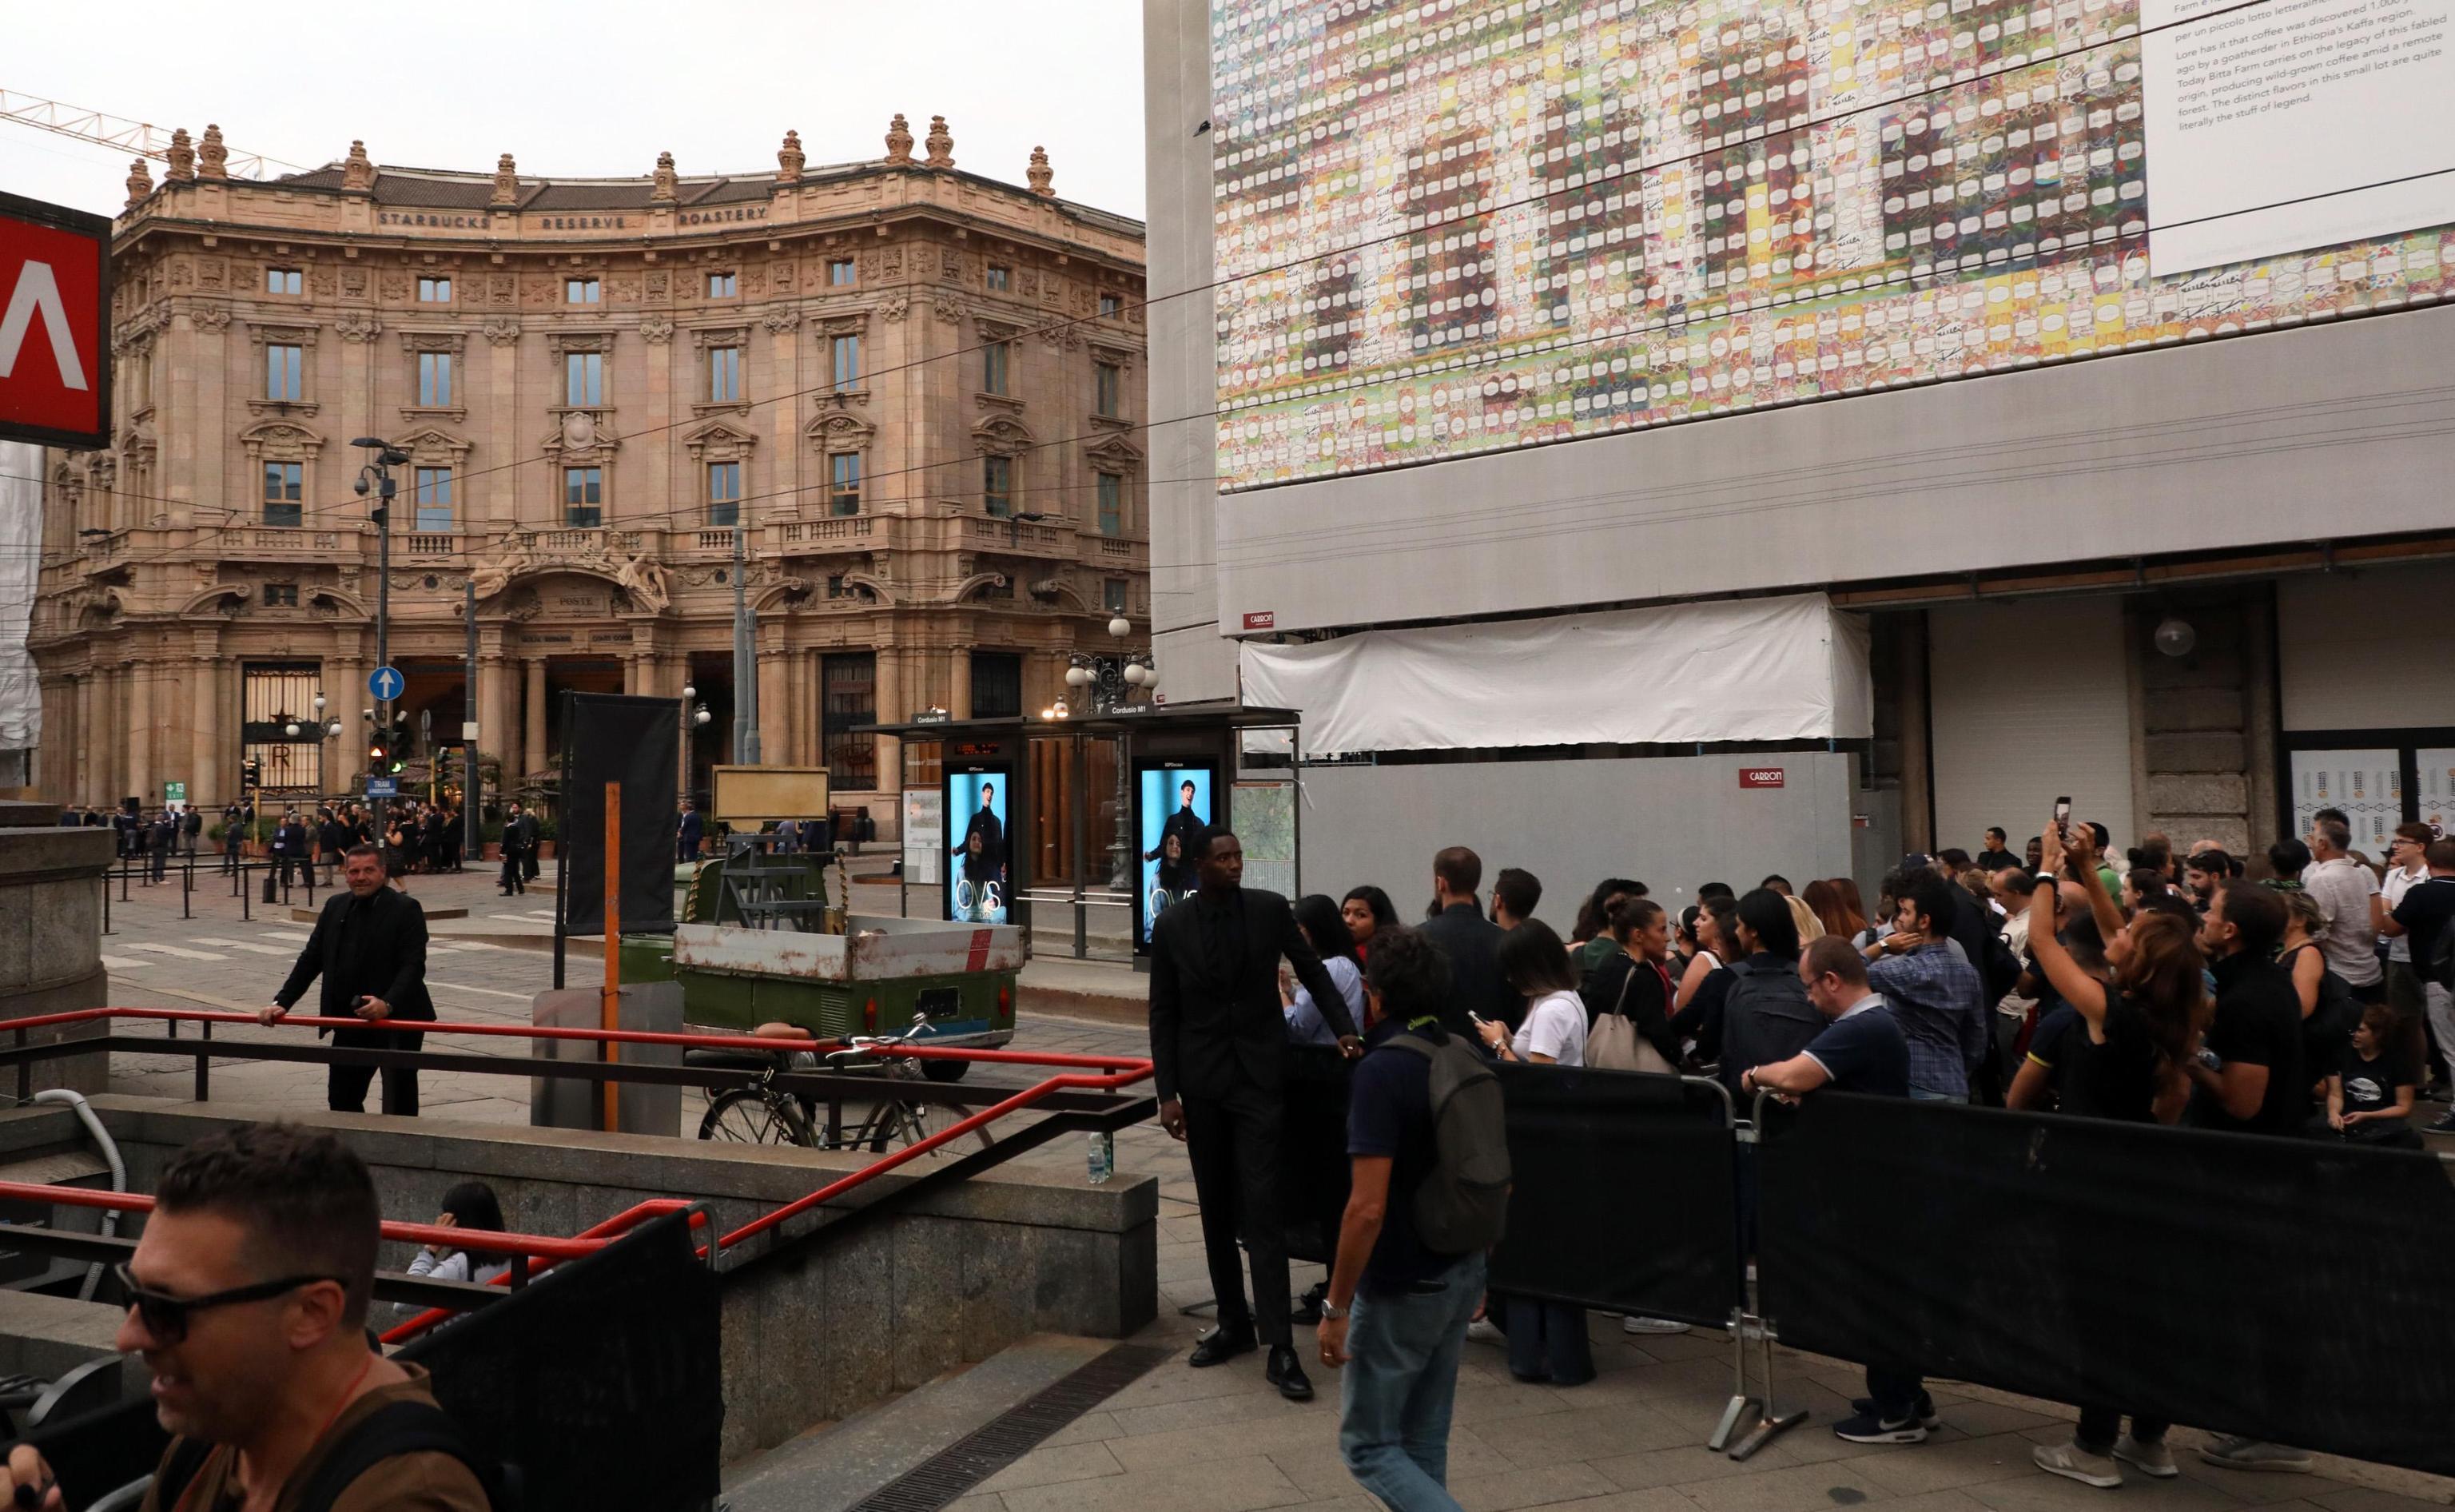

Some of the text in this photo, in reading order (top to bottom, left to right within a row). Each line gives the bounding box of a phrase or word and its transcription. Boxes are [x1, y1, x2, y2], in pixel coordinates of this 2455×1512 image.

[2174, 2, 2198, 13] Farm
[2175, 32, 2191, 44] per
[2194, 28, 2206, 37] un
[2210, 18, 2245, 34] piccolo
[2248, 10, 2272, 25] lotto
[2176, 49, 2197, 60] Lore
[2200, 44, 2217, 54] has
[2229, 36, 2249, 46] that
[2251, 28, 2283, 41] coffee
[2286, 22, 2306, 32] was
[2309, 4, 2366, 26] discovered
[2176, 64, 2195, 75] ago
[2198, 59, 2210, 70] by
[2221, 42, 2277, 66] goatherder
[2281, 39, 2290, 48] in
[2294, 26, 2343, 45] Ethiopia's
[2346, 19, 2373, 31] Kaffa
[2377, 9, 2416, 24] region.
[2178, 76, 2206, 89] Today
[2209, 70, 2232, 81] Bitta
[2234, 62, 2260, 74] Farm
[2263, 54, 2297, 68] carries
[2316, 43, 2334, 54] the
[2336, 35, 2371, 50] legacy
[2373, 30, 2385, 40] of
[2389, 25, 2409, 36] this
[2411, 14, 2447, 30] fabled
[2178, 90, 2208, 103] origin,
[2211, 77, 2262, 96] producing
[2266, 62, 2322, 81] wild-grown
[2326, 54, 2359, 67] coffee
[2361, 44, 2389, 58] amid
[2402, 33, 2443, 48] remote
[2178, 48, 2442, 117] forest. The distinct flavors in this small lot are quite
[2179, 94, 2313, 131] literally the stuff of legend.
[379, 207, 766, 229] STARBUCKS RESERVE ROASTERY
[560, 597, 593, 606] POSTE
[1250, 614, 1272, 623] CARRON
[1750, 771, 1782, 781] CARRON
[957, 879, 1001, 911] OVS
